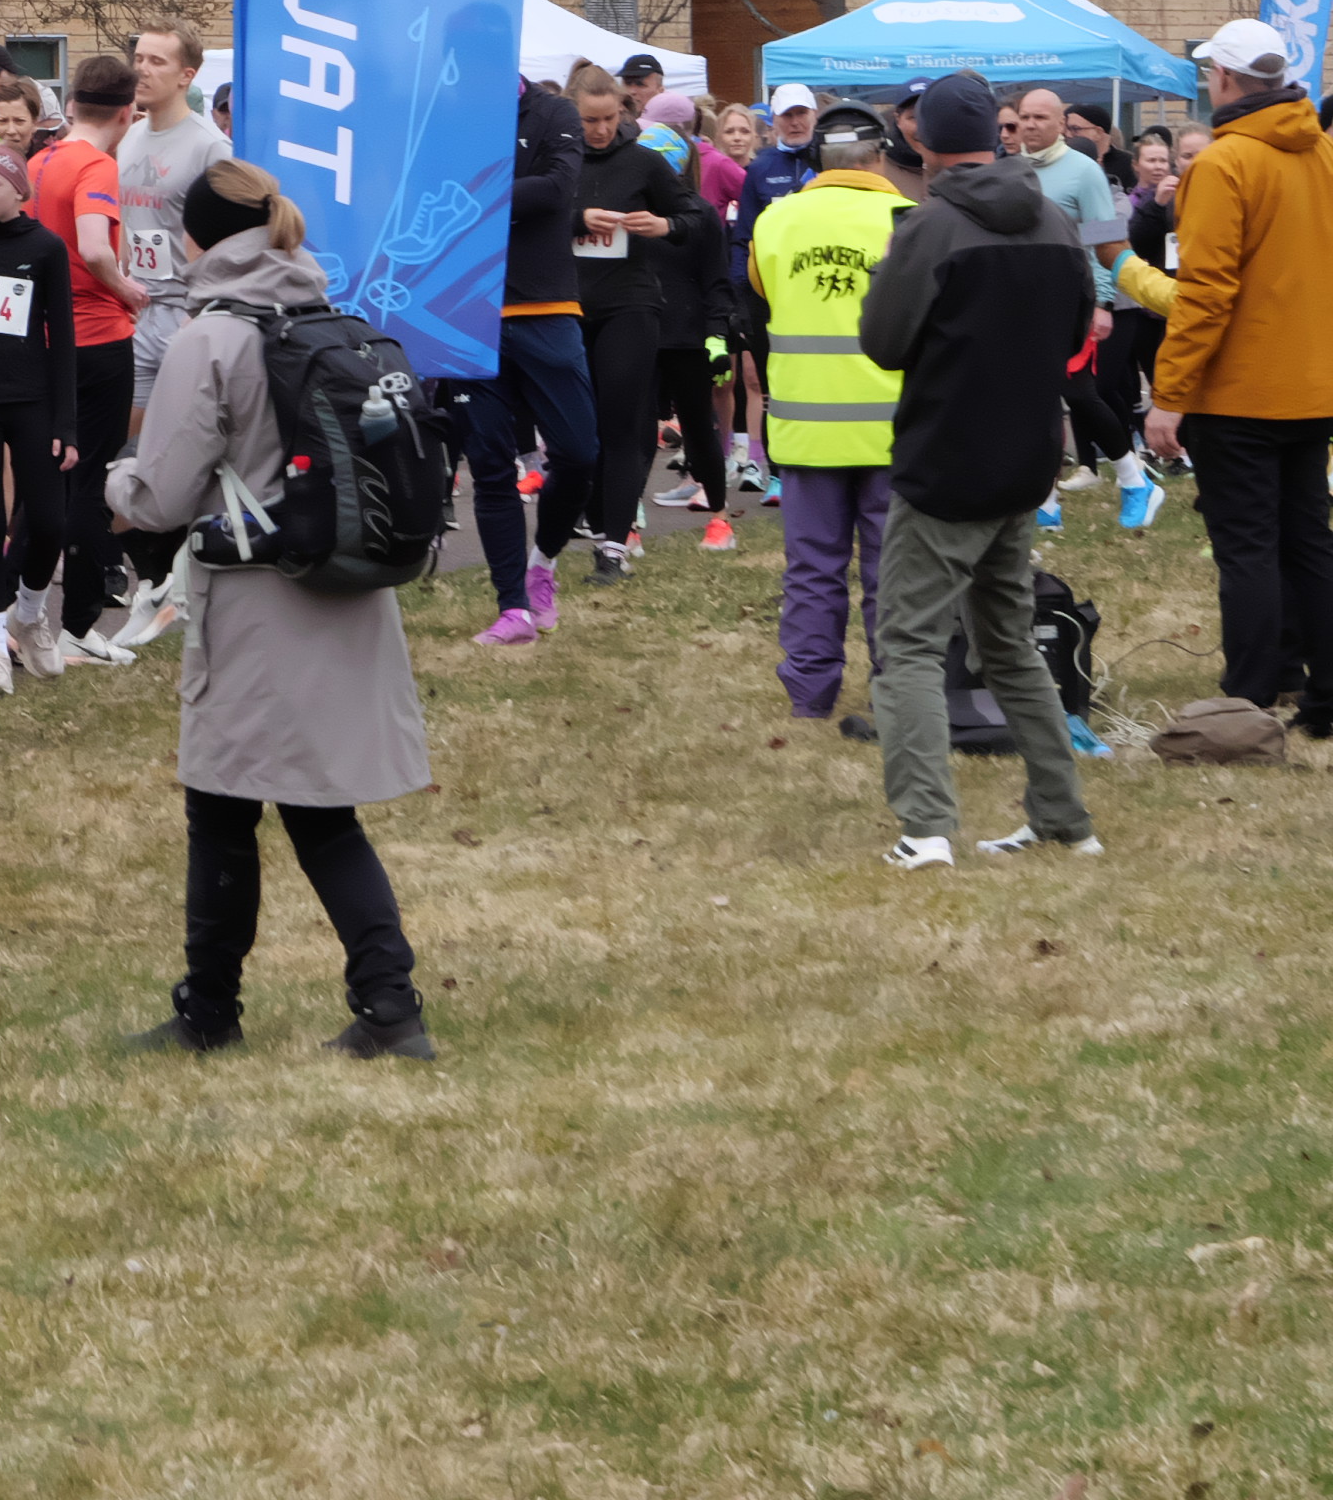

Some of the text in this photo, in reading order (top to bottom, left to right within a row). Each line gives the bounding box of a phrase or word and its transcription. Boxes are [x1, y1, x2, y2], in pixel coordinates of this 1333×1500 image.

[820, 56, 891, 71] Tuusula
[906, 53, 987, 68] Elämisen
[992, 52, 1063, 67] taidetta.
